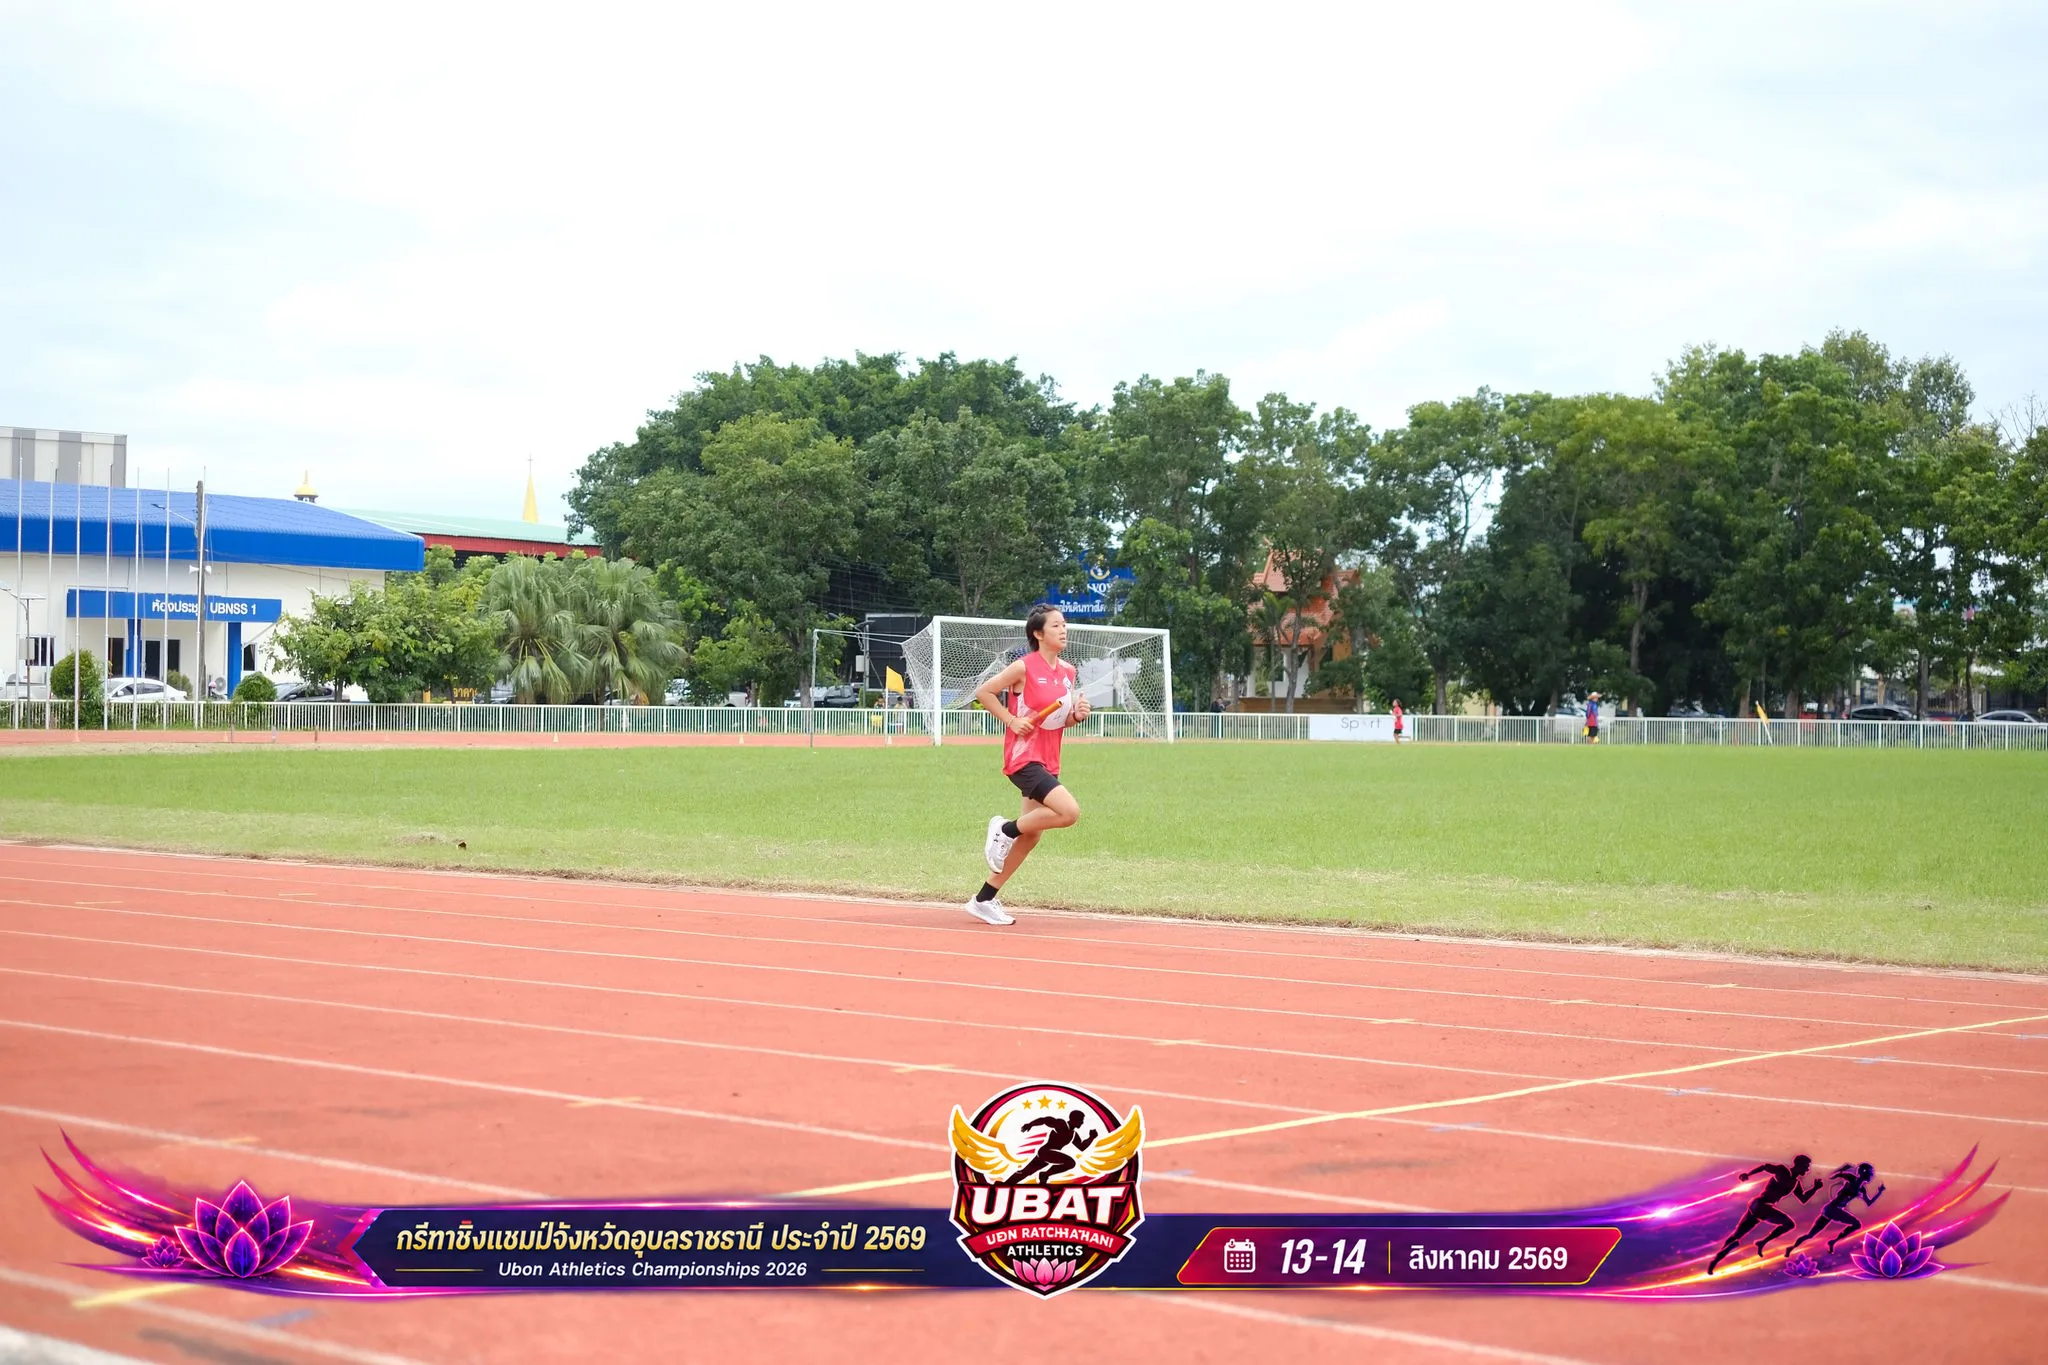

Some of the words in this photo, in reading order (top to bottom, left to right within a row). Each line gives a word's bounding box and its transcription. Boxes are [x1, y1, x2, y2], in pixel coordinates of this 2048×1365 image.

[152, 598, 206, 617] ห้องประชุ
[209, 602, 248, 616] UBNSS
[250, 603, 257, 616] 1
